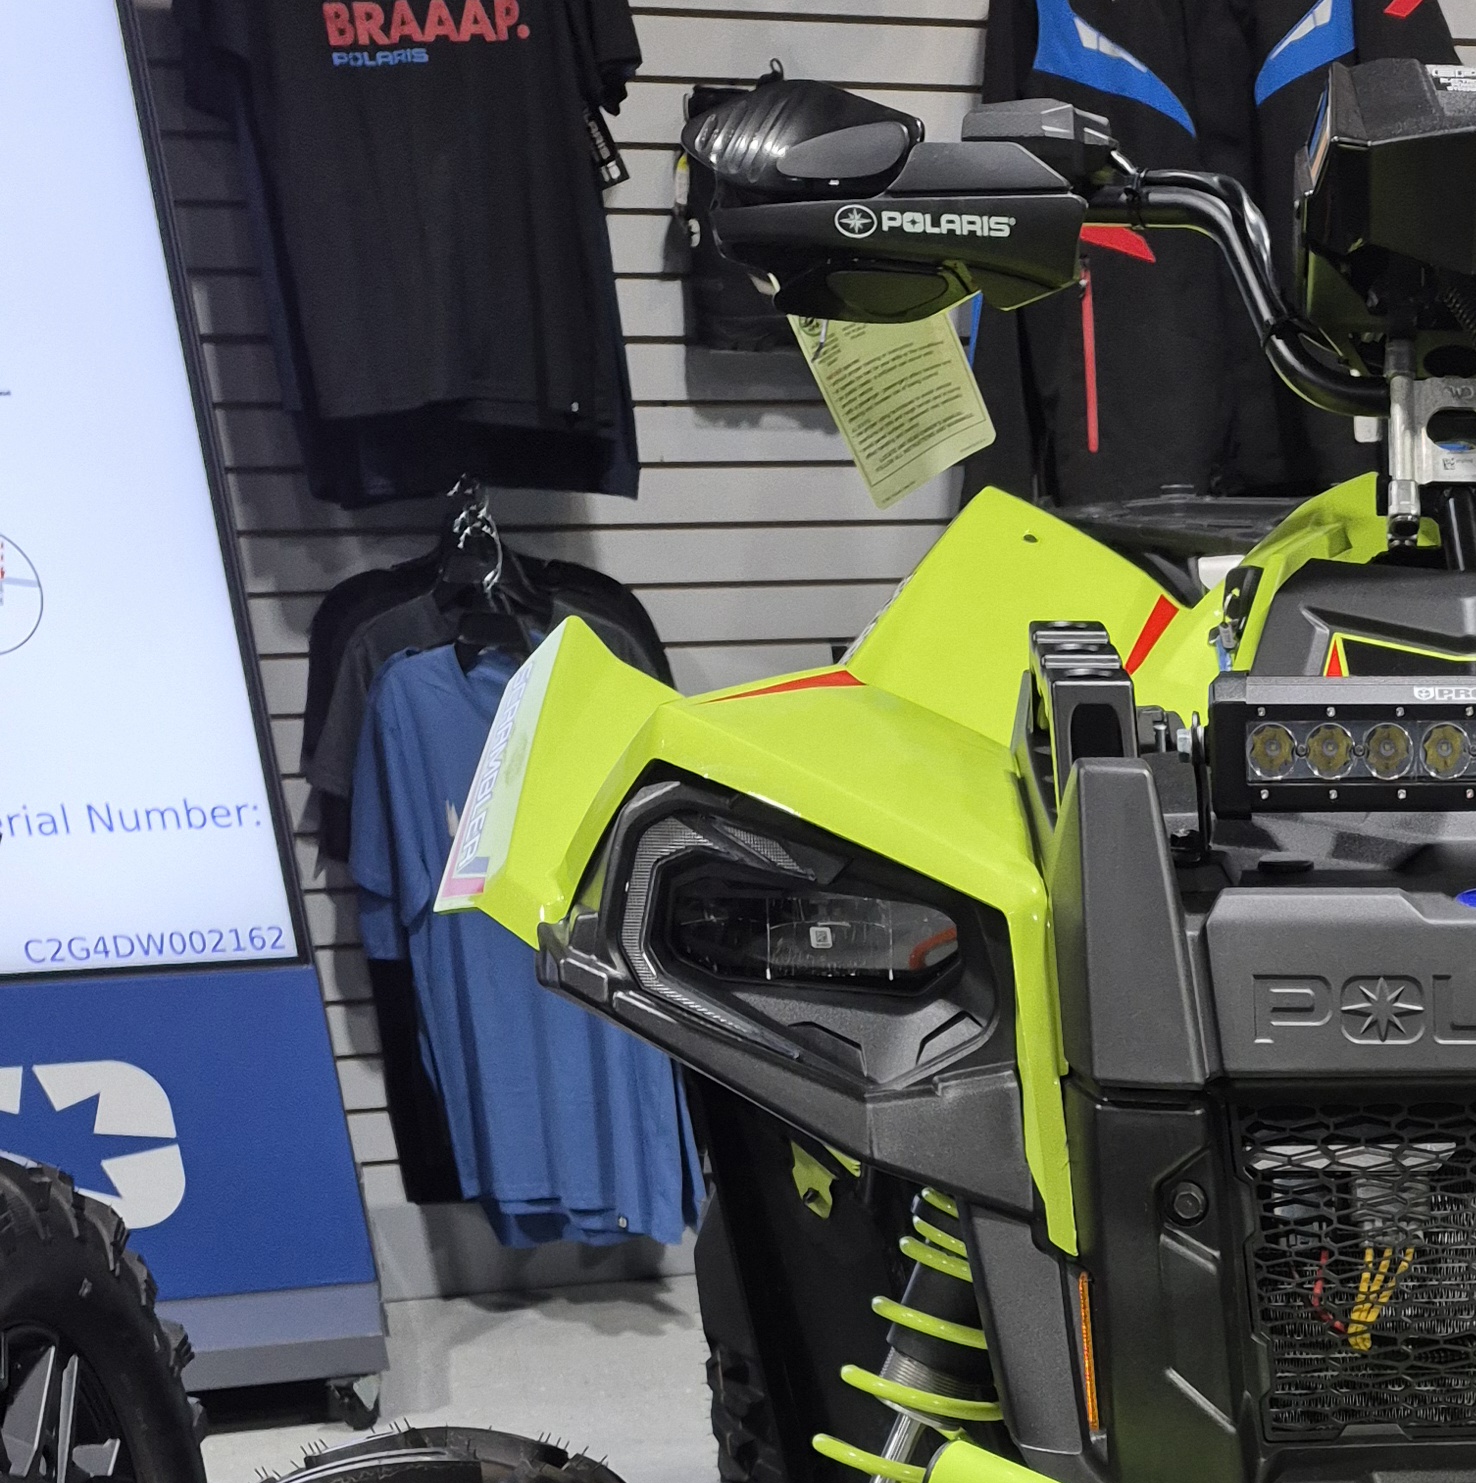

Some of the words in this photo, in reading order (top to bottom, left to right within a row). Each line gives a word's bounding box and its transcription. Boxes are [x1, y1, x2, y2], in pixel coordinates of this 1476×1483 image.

[322, 0, 530, 46] BRAAAP.
[332, 48, 429, 67] POLARIS
[881, 210, 1012, 237] POLARIS
[0, 803, 70, 836] rial
[86, 798, 261, 833] Number:
[24, 926, 286, 964] C2G4DW002162
